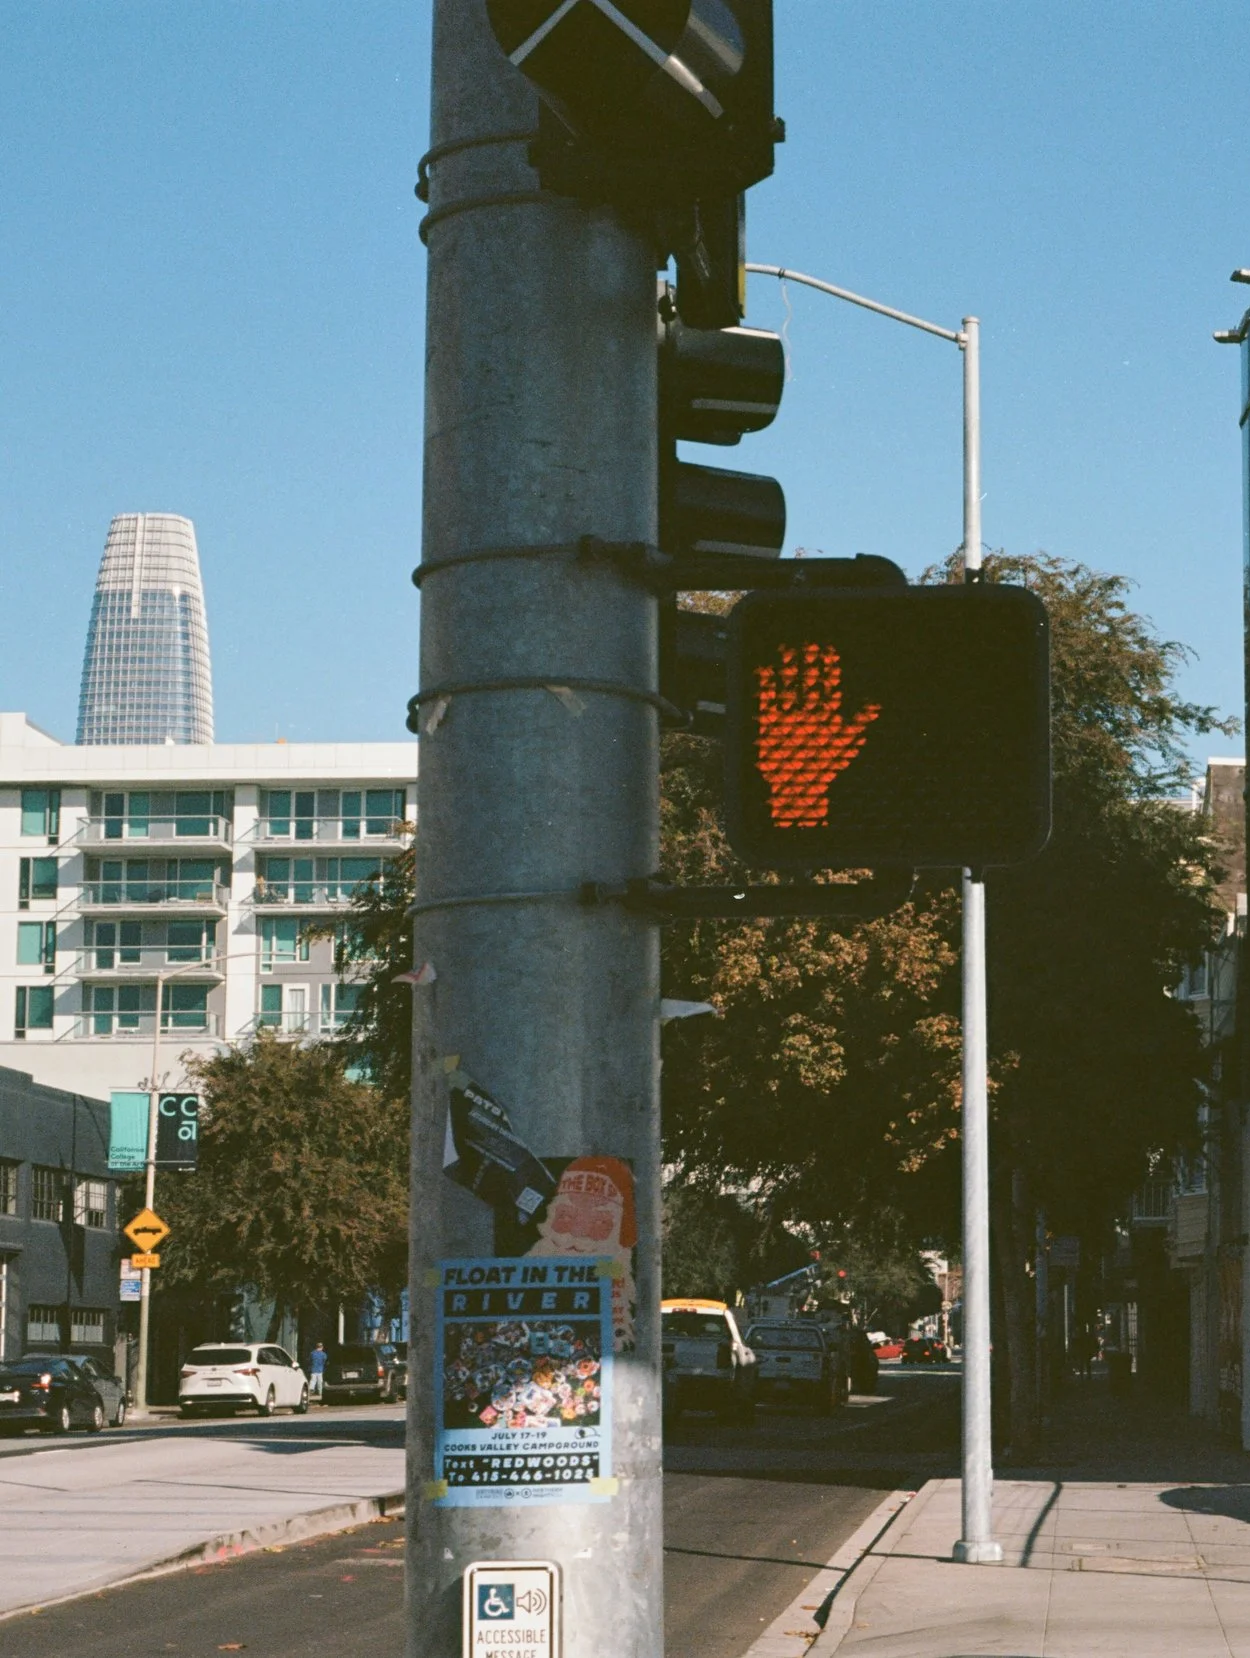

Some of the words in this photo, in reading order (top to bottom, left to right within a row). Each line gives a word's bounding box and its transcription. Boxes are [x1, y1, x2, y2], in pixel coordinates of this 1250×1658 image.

[444, 1265, 517, 1285] FLOAT
[521, 1265, 549, 1283] IN
[553, 1264, 599, 1283] THE
[452, 1291, 590, 1313] RIVER
[491, 1432, 517, 1440] JULY
[520, 1431, 548, 1440] 17-19
[443, 1444, 477, 1452] COOKS
[479, 1442, 519, 1451] VALLEY
[522, 1441, 599, 1450] CAMPGROUND
[444, 1458, 475, 1469] Text
[449, 1471, 465, 1482] To
[471, 1468, 595, 1482] 415-446-1025
[477, 1629, 546, 1645] ACCESSIBLE
